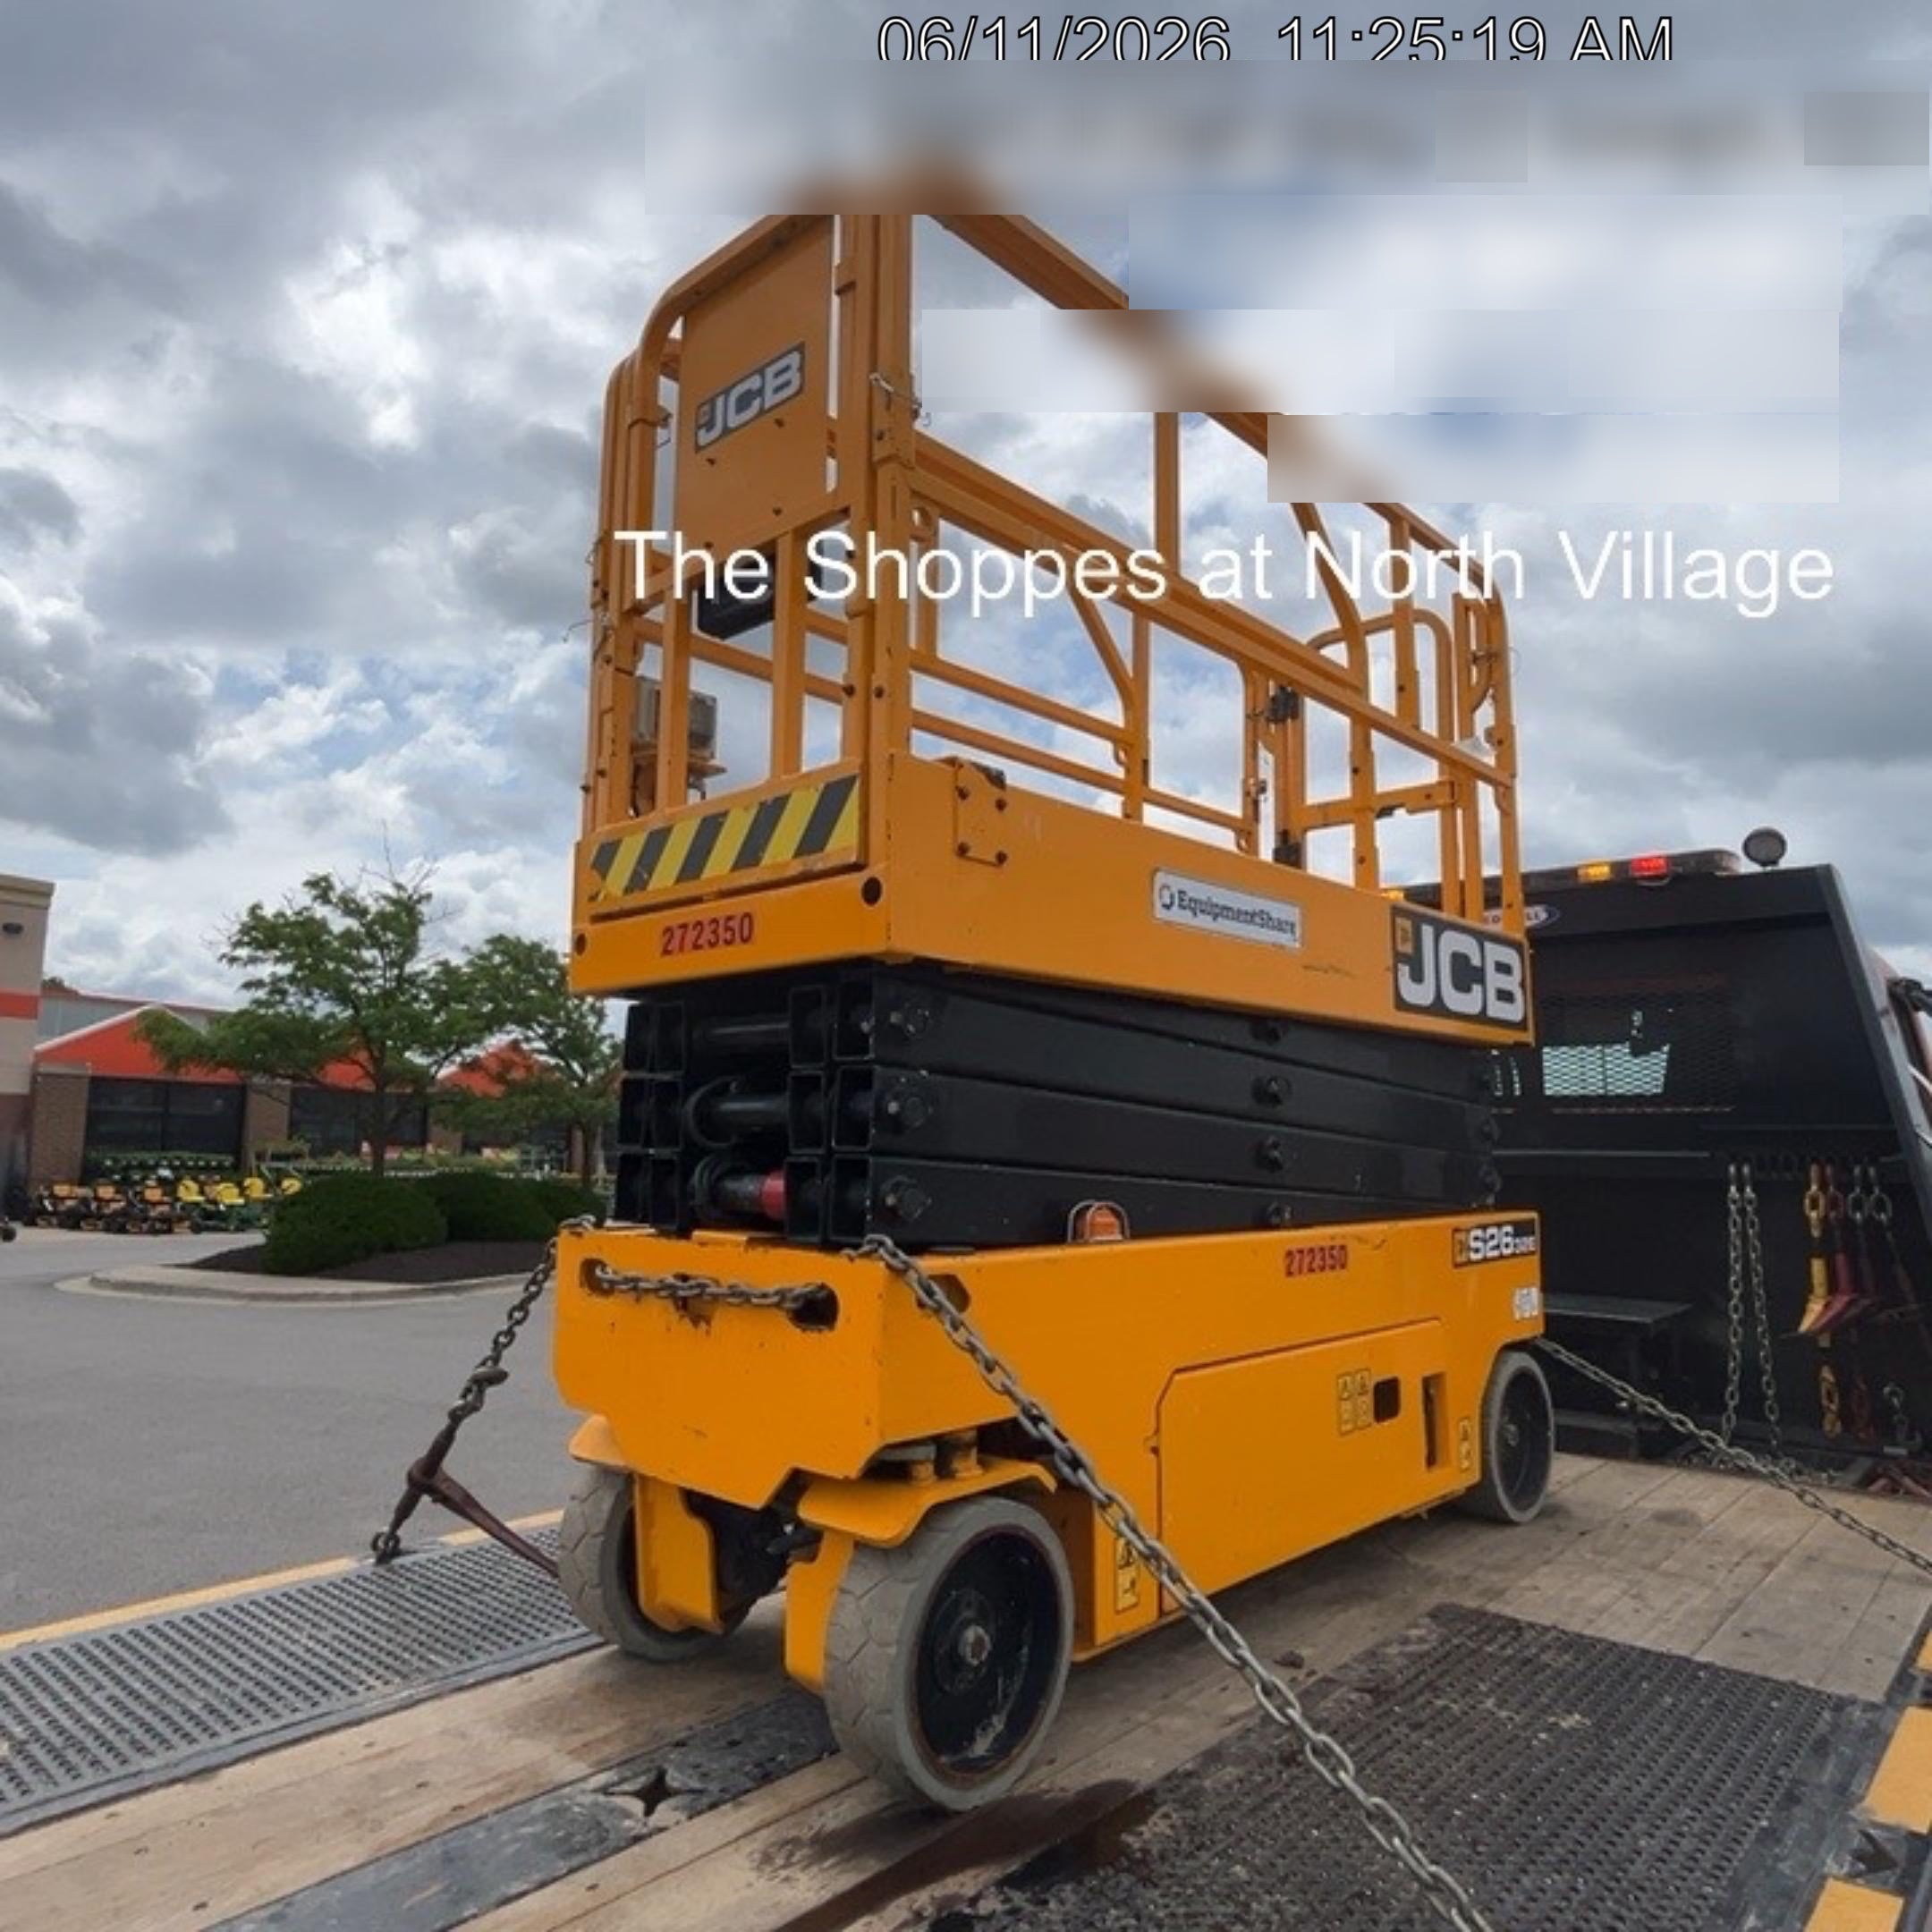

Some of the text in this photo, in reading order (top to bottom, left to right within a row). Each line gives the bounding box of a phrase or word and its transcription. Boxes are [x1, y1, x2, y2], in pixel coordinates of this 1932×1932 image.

[697, 350, 801, 447] JCB
[660, 911, 754, 957] 272350
[1396, 924, 1526, 1024] JCB
[1284, 1244, 1348, 1278] 272350
